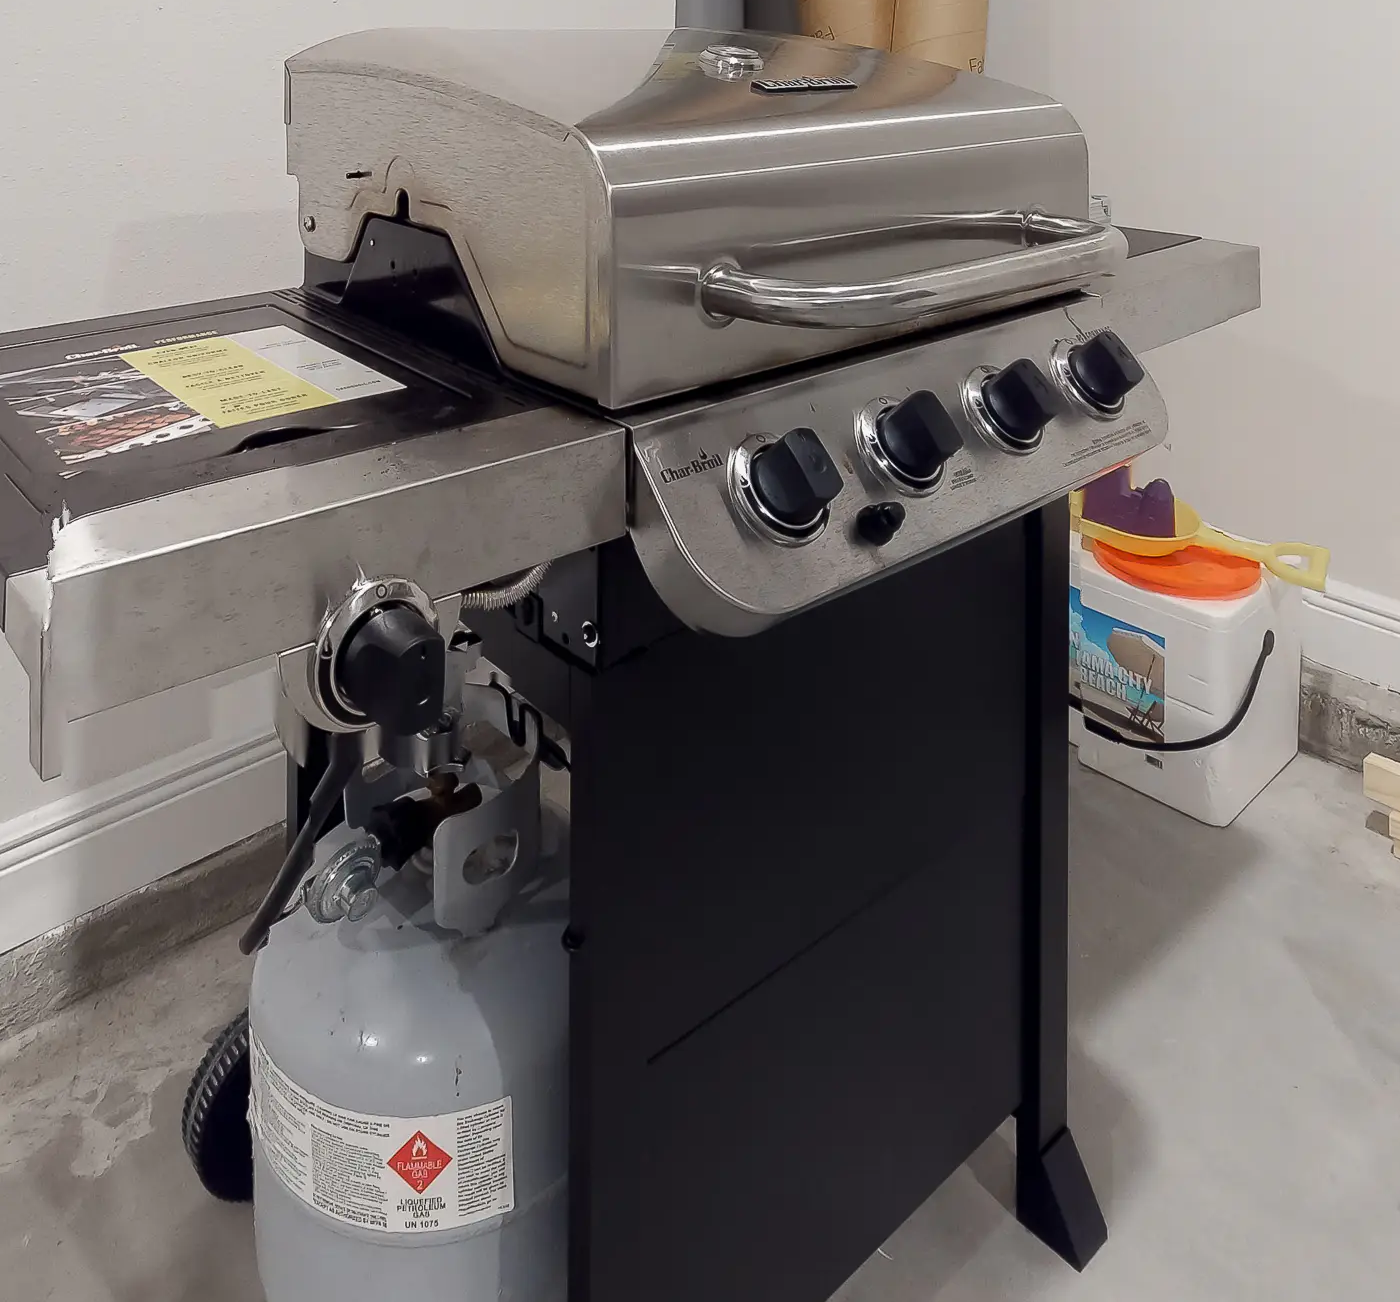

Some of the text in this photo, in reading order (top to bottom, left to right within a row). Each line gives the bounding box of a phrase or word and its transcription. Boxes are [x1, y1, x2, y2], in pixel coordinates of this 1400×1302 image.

[1081, 666, 1127, 701] BEACH
[1118, 666, 1152, 695] CITY
[397, 1159, 443, 1171] FLAMMABLE
[411, 1169, 428, 1178] GAS
[417, 1180, 423, 1190] 2
[396, 1203, 446, 1212] PETROLEUM
[405, 1220, 417, 1228] UN
